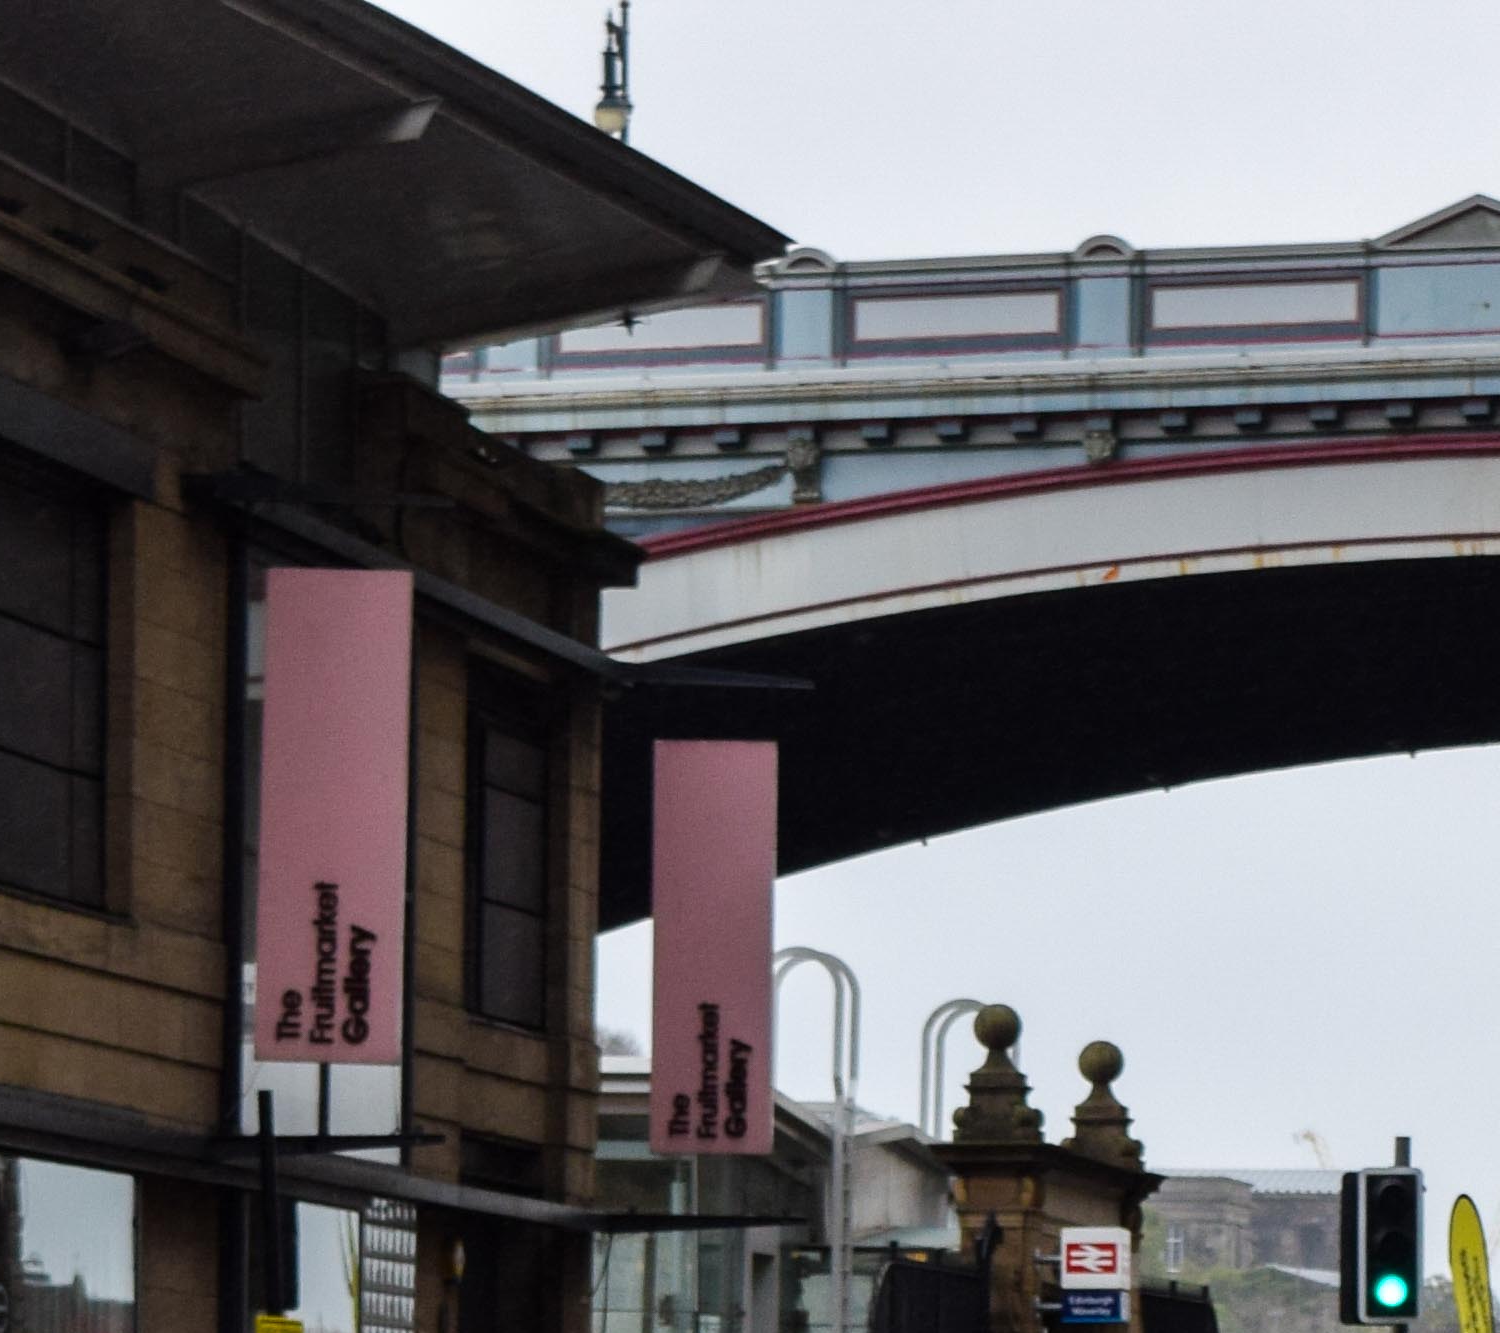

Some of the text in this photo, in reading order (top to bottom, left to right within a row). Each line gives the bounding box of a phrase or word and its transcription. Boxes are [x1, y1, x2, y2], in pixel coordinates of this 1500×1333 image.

[308, 882, 339, 1045] Fruitmarket
[342, 924, 378, 1045] Gallery
[276, 990, 302, 1043] The
[696, 1003, 719, 1139] Fruitmarket
[724, 1039, 753, 1140] Gallery
[668, 1093, 690, 1138] The
[1068, 1296, 1114, 1306] Edinburgh
[1071, 1308, 1112, 1316] Waverley
